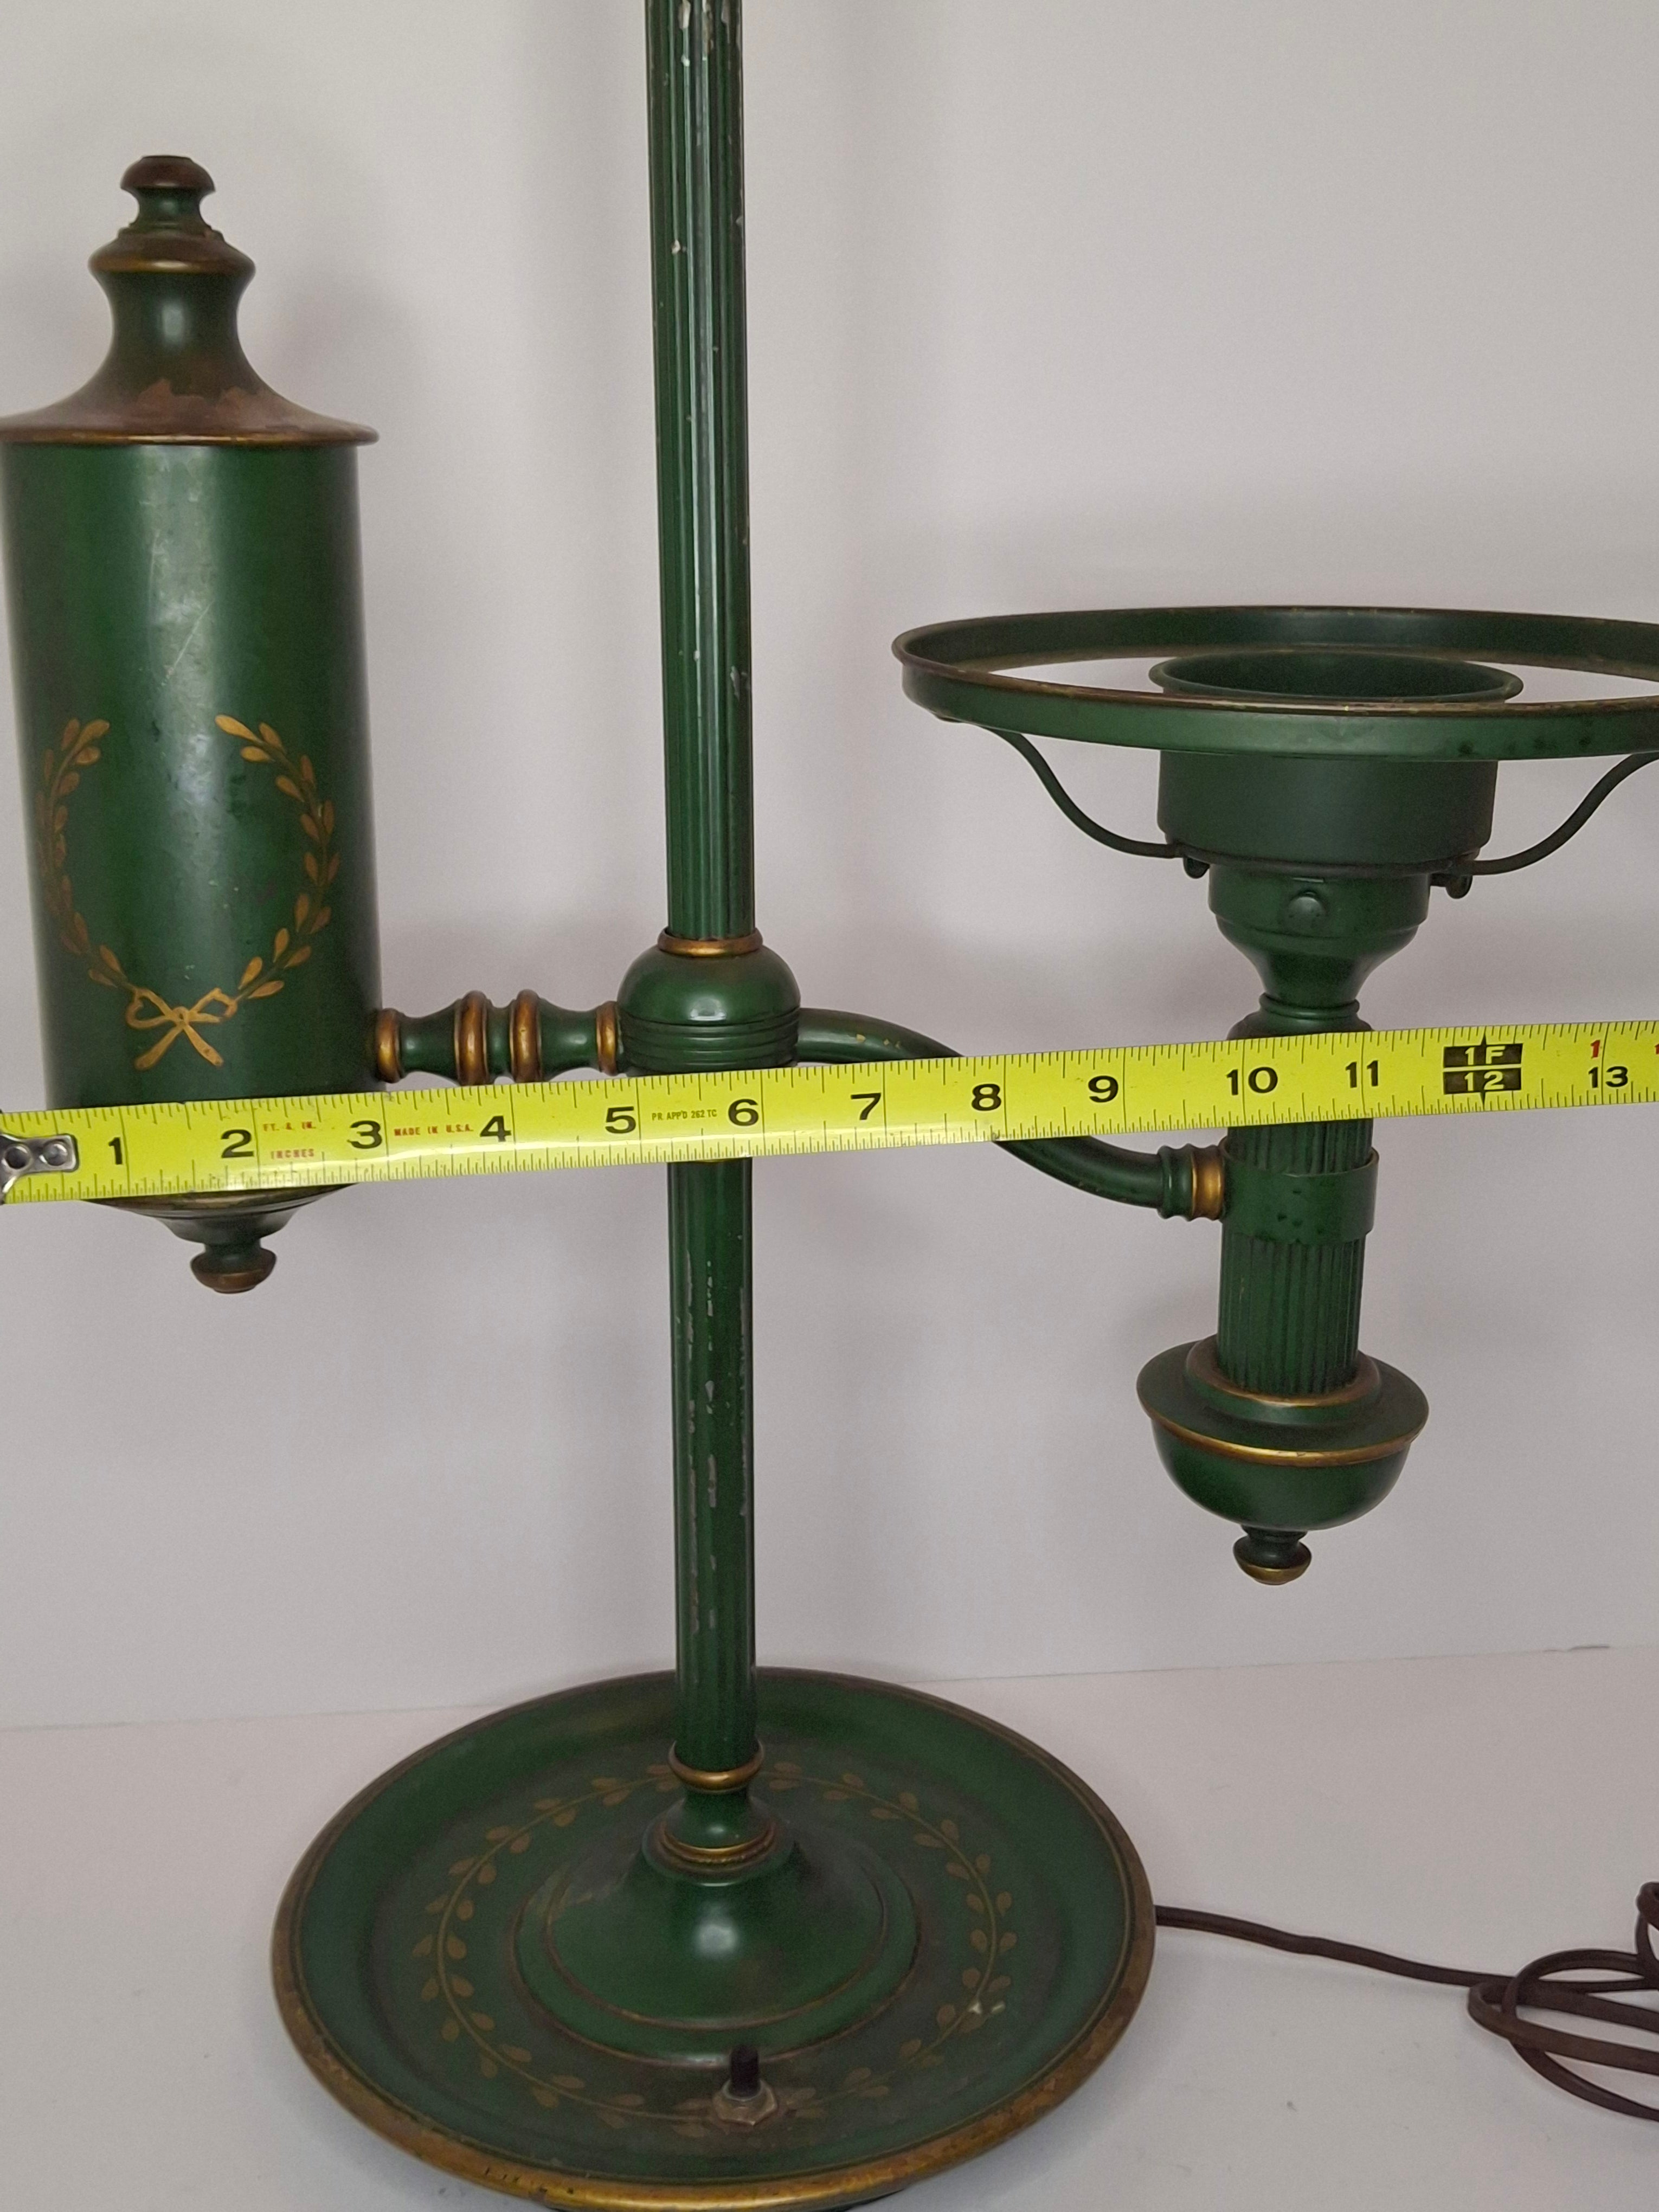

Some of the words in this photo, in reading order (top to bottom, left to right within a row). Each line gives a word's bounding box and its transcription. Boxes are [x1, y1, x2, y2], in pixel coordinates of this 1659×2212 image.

[1590, 1040, 1600, 1058] 1
[1226, 1066, 1278, 1096] 10
[1346, 1060, 1379, 1088] 11
[1464, 1071, 1504, 1091] 12
[1588, 1066, 1628, 1088] 13
[972, 1084, 1001, 1110] 8
[1088, 1076, 1118, 1102] 9
[666, 1110, 687, 1120] APP'D
[691, 1110, 705, 1119] 262
[707, 1109, 717, 1117] TC
[728, 1098, 759, 1127] 6
[851, 1092, 882, 1120] 7
[285, 1122, 294, 1130] &
[394, 1127, 420, 1136] MADE
[427, 1126, 438, 1134] IN
[446, 1124, 473, 1133] U.S.A.
[480, 1115, 512, 1142] 4
[605, 1107, 636, 1134] 5
[221, 1130, 254, 1158] 2
[346, 1120, 383, 1149] 3
[108, 1137, 122, 1165] 1
[271, 1148, 314, 1160] INCHES
